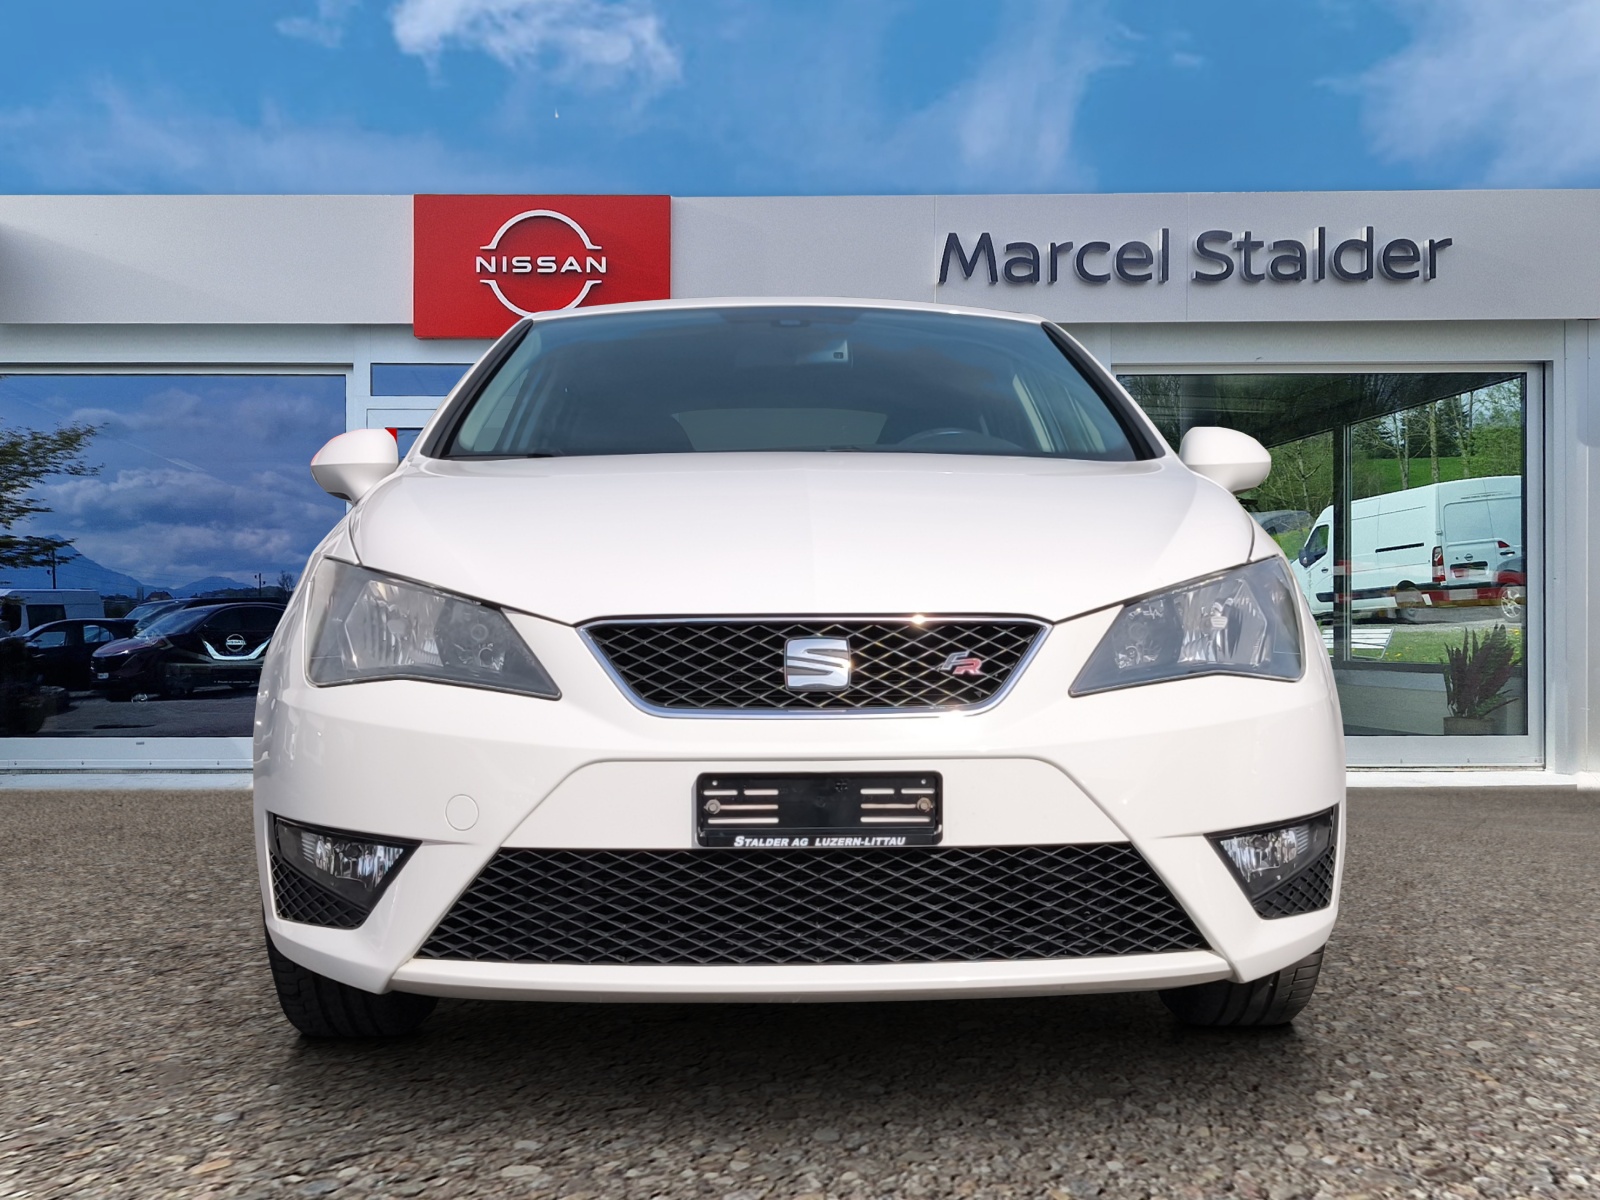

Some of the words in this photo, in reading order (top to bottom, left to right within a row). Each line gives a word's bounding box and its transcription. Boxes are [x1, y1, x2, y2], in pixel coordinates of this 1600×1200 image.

[475, 256, 607, 273] NISSAN
[939, 228, 1170, 284] Marcel
[1192, 226, 1453, 283] Stalder
[941, 651, 983, 675] FR
[791, 838, 809, 847] AG
[814, 836, 906, 847] LUZERN-LITTAU
